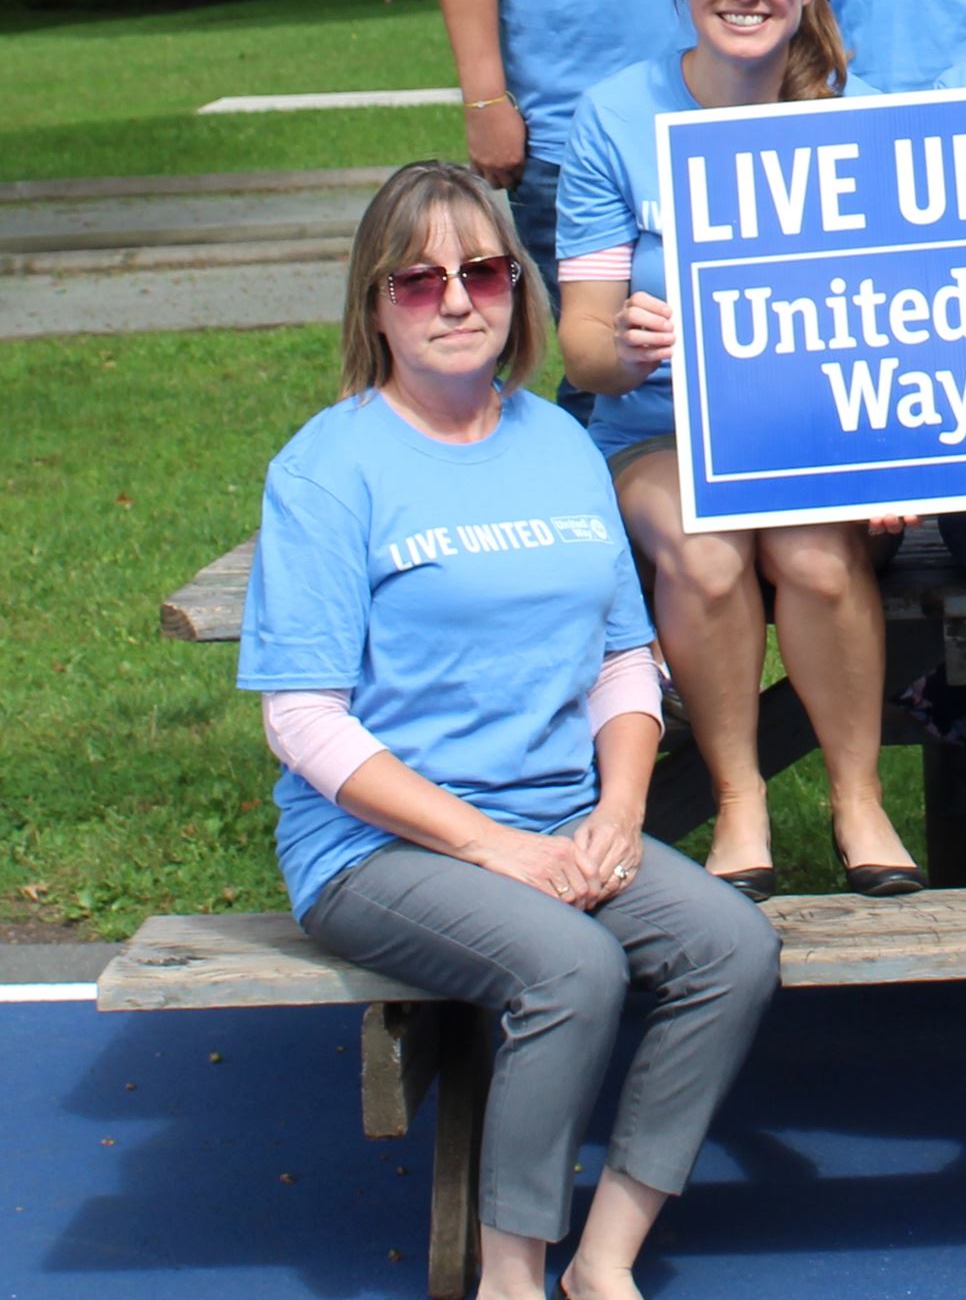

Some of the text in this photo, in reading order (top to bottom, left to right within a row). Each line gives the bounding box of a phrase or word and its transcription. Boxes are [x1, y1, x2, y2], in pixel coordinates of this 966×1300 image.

[687, 142, 867, 243] LIVE
[389, 519, 555, 571] LIVE UNITED
